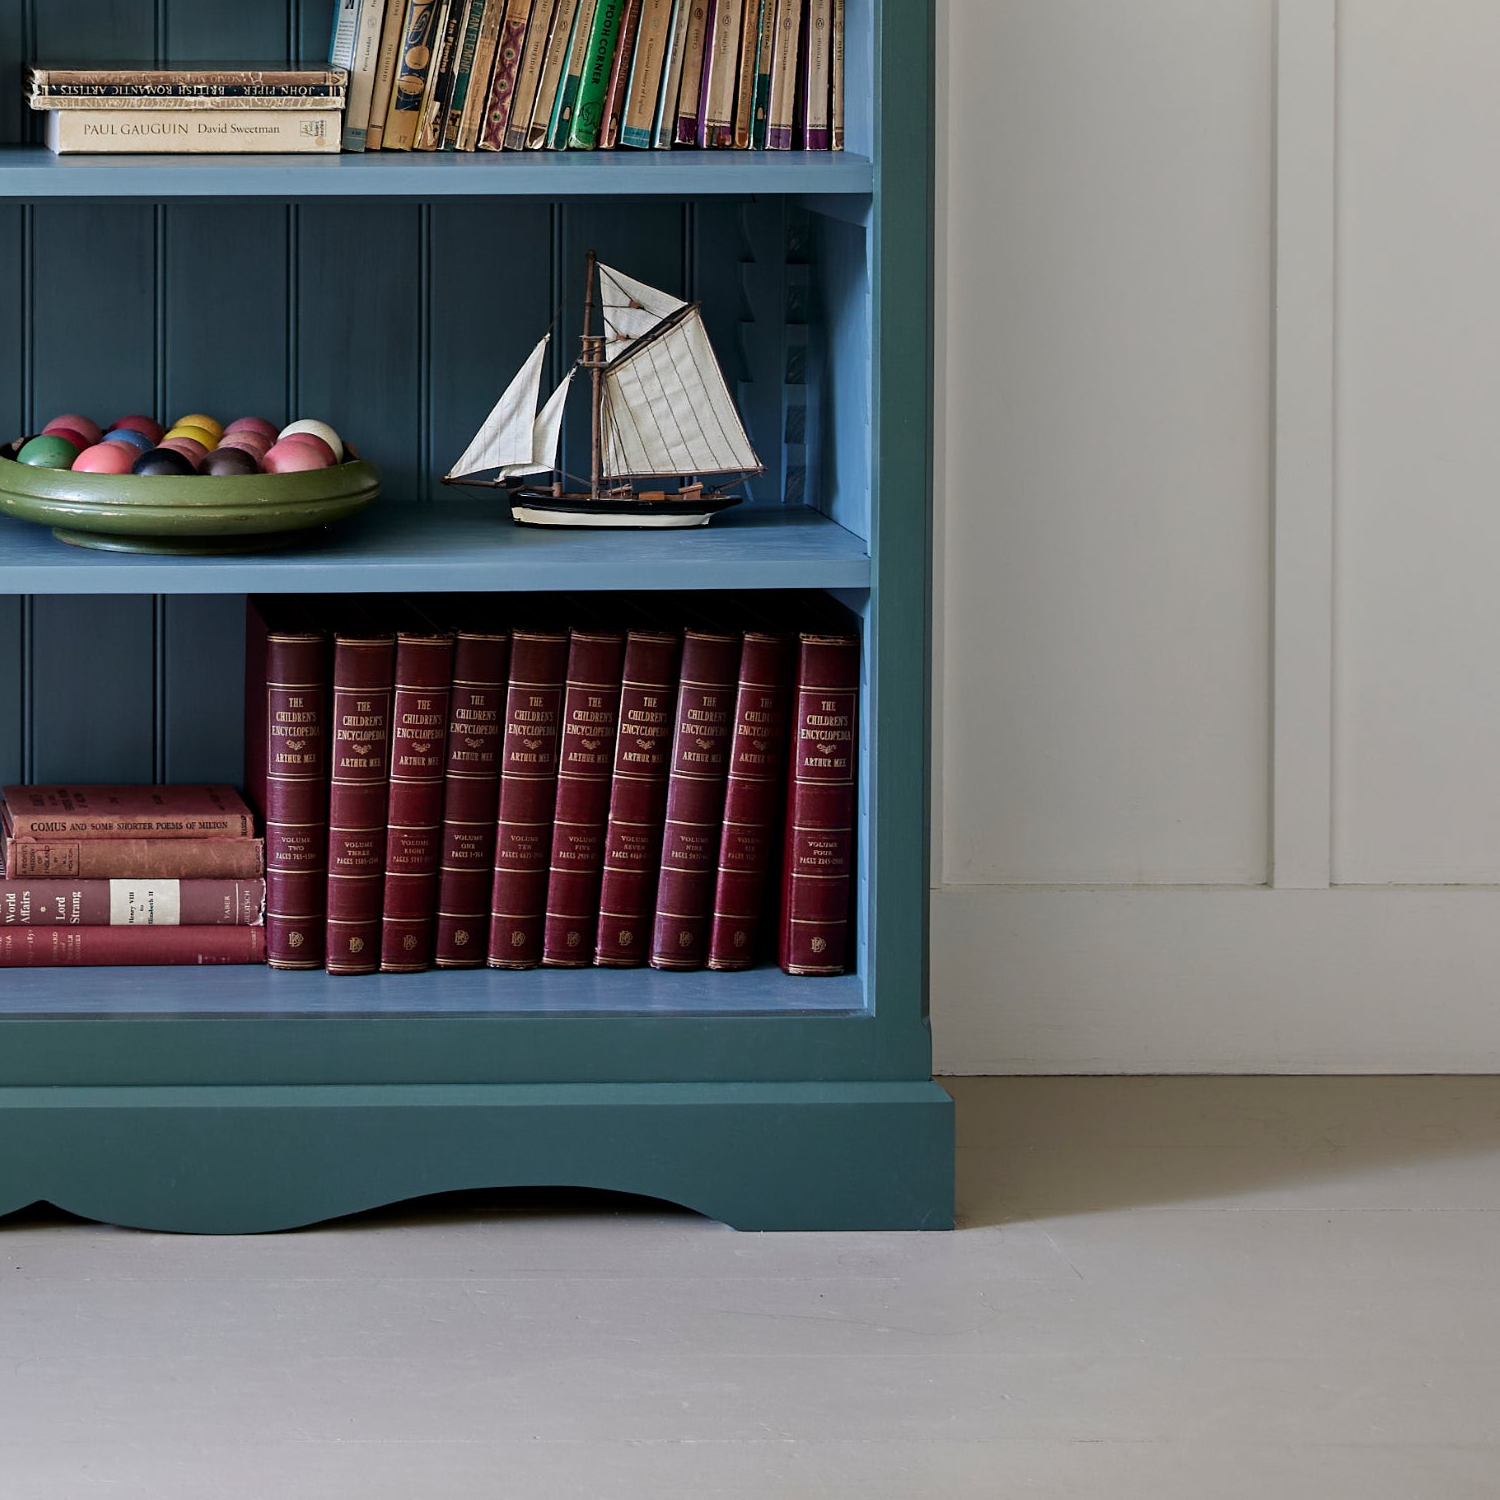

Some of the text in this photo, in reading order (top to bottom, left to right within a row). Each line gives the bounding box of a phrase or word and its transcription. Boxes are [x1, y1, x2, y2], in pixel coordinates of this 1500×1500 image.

[601, 5, 614, 36] POOH
[439, 37, 456, 74] Fleming
[460, 34, 477, 74] FLEMING
[591, 39, 608, 85] CORNER
[170, 74, 206, 82] MARSH
[60, 85, 314, 96] JOHN PIPER BRITISH ROMANTIC ARTISTS
[84, 124, 280, 135] PAUL GAUGUIN David Sweetman
[289, 698, 304, 707] THE
[417, 700, 431, 710] THE
[471, 695, 484, 705] THE
[530, 697, 544, 707] THE
[357, 702, 371, 711] THE
[821, 701, 836, 711] THE
[276, 712, 316, 722] CHILDREN'S
[403, 714, 442, 724] CHILDREN'S
[456, 709, 497, 720] CHILDREN'S
[515, 710, 554, 721] CHILDREN'S
[343, 716, 382, 726] CHILDREN'S
[807, 715, 848, 726] CHILDREN'S
[272, 726, 320, 737] ENCYCLOPEDIA
[397, 728, 444, 739] ENCYCLOPEDIA
[450, 723, 499, 735] ENCYCLOPEDIA
[508, 724, 555, 736] ENCYCLOPEDIA
[801, 729, 851, 740] ENCYCLOPEDIA
[337, 730, 385, 740] ENCYCLOPEDIA
[276, 754, 316, 763] ARTHUR MEE
[399, 756, 438, 766] ARTHUR MEE
[452, 751, 493, 761] ARTHUR MEE
[510, 752, 550, 762] ARTHUR MEE
[341, 758, 381, 767] ARTHUR MEE
[804, 758, 846, 767] ARTHUR MEE
[31, 822, 67, 832] COMUS
[70, 823, 87, 831] AND
[91, 823, 113, 831] SOME
[117, 822, 153, 831] SHORTER
[156, 822, 183, 830] POEMS
[198, 821, 228, 829] MILTON
[6, 893, 16, 923] World
[21, 891, 31, 923] Affairs
[56, 896, 66, 920] Lord
[72, 892, 81, 924] Strang
